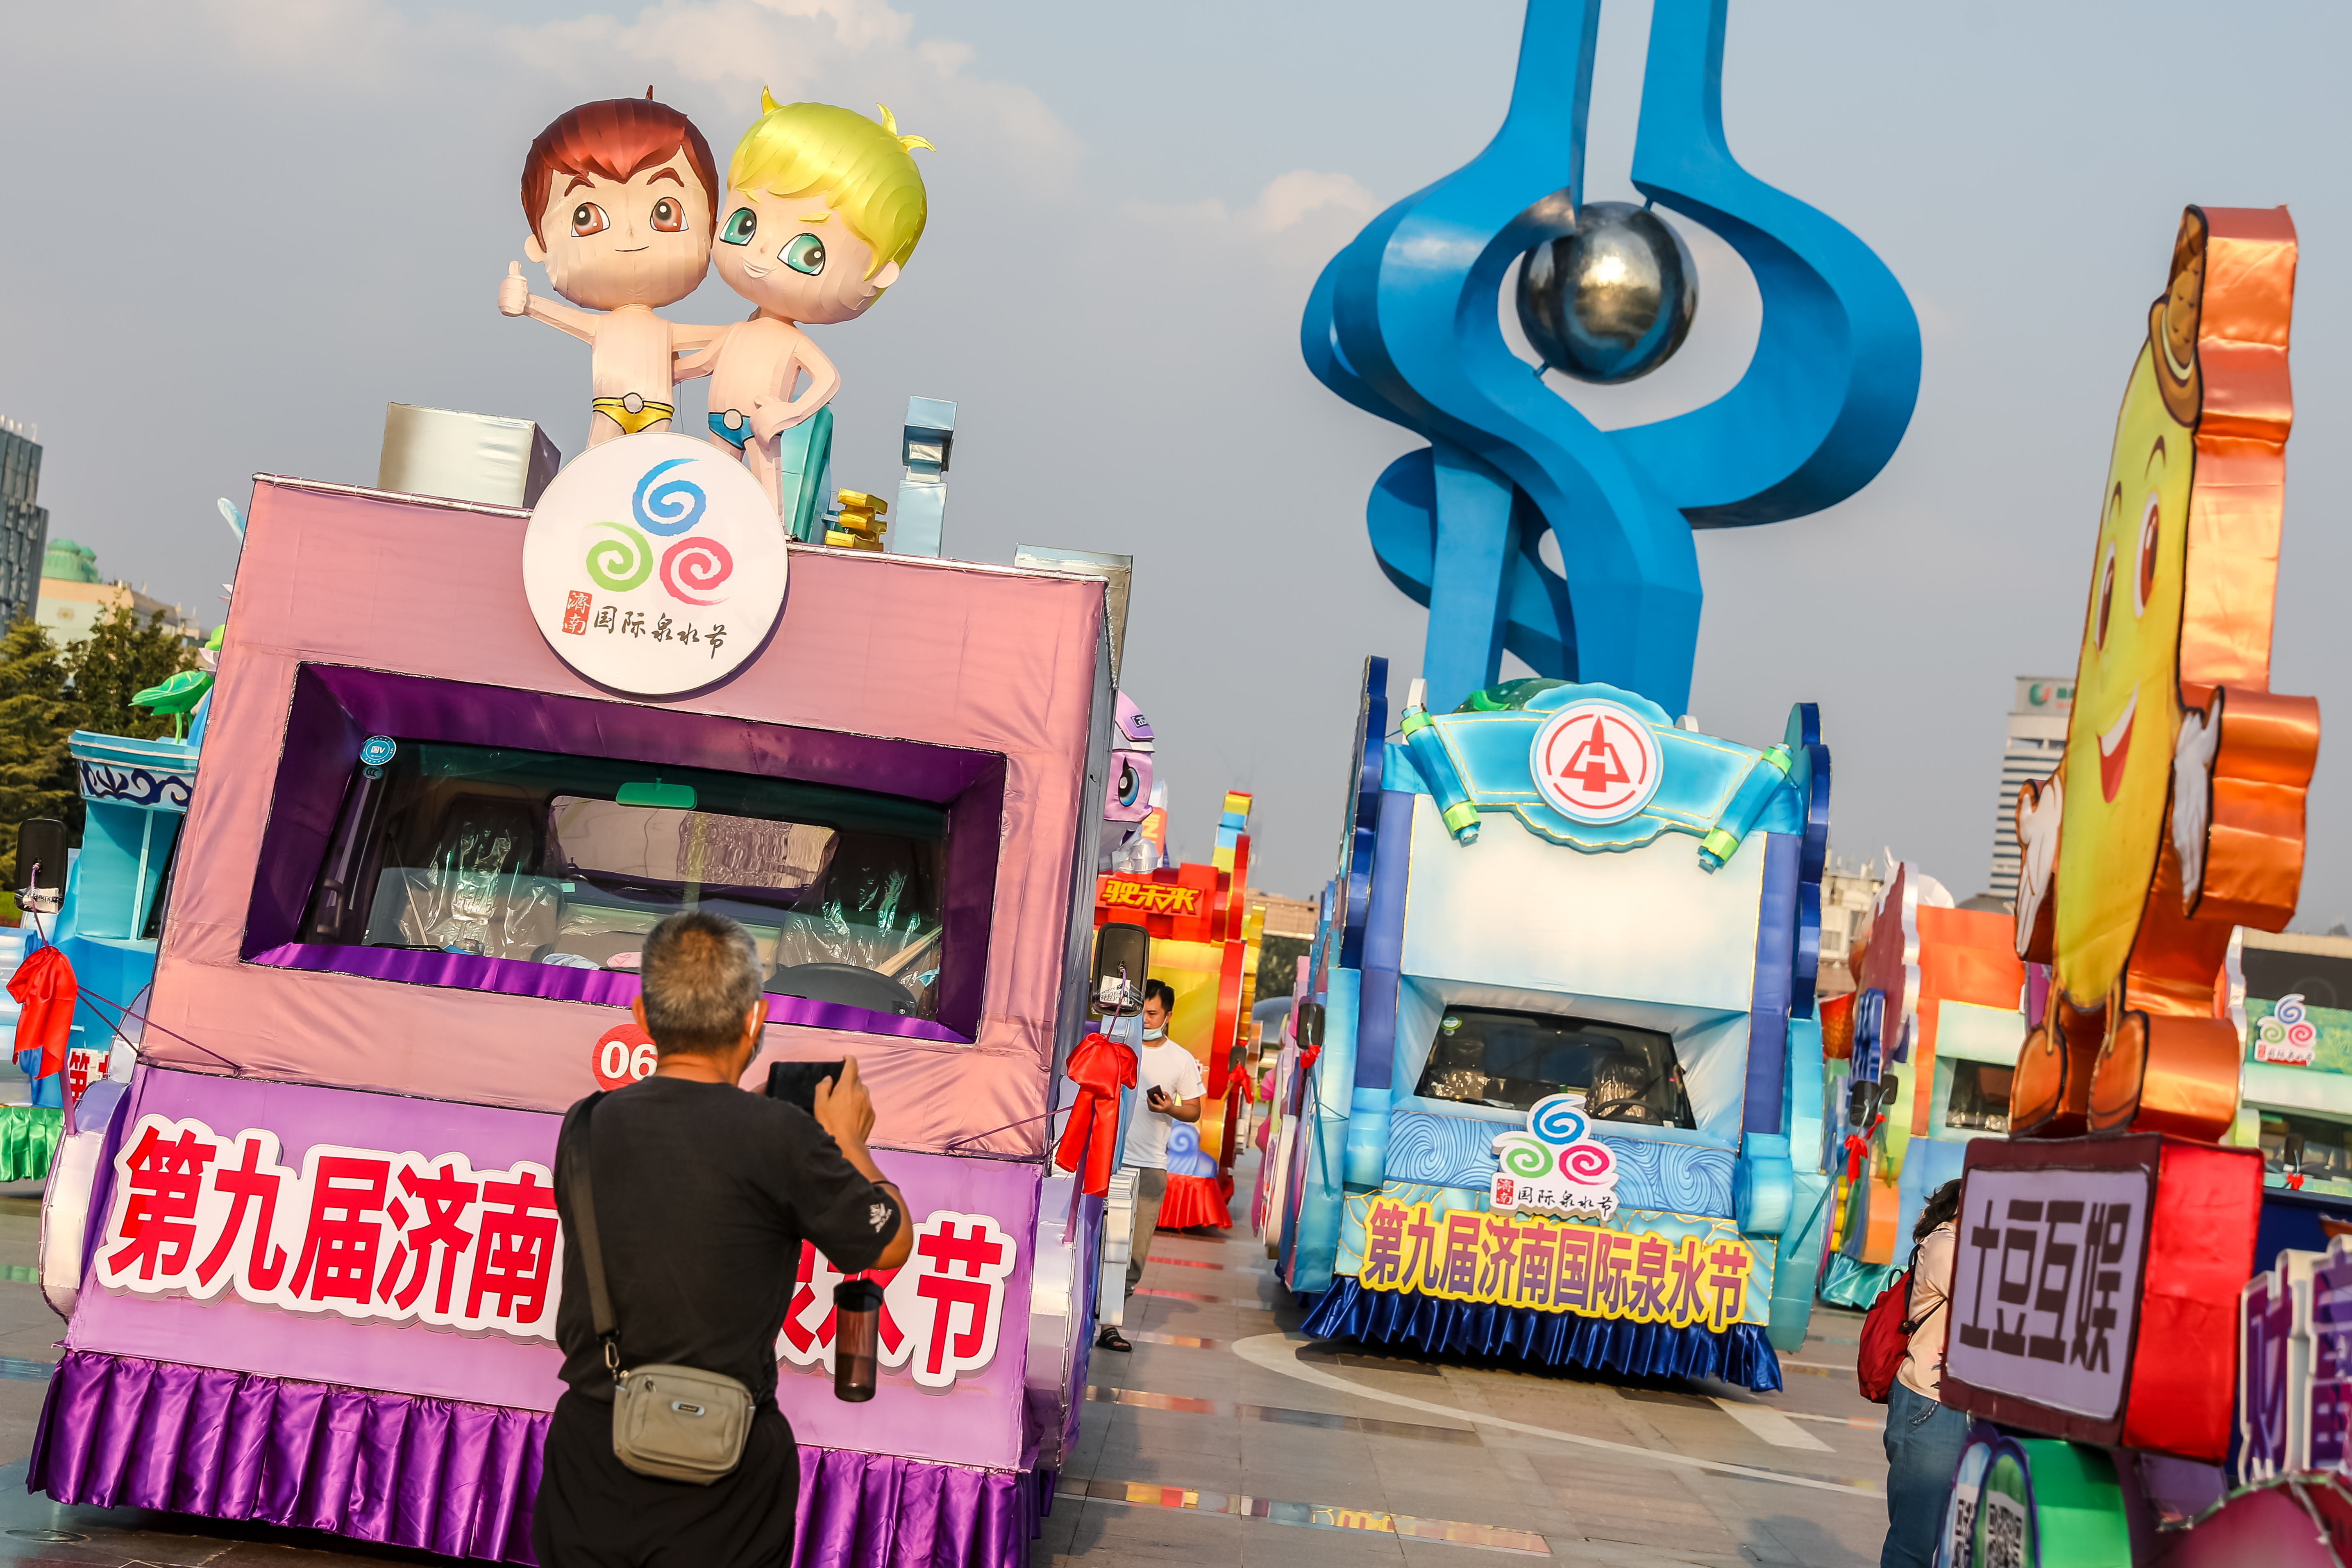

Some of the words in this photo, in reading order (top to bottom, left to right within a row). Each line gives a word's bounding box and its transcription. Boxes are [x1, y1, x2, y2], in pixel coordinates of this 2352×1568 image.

[1102, 880, 1200, 911] 驶未来
[601, 1040, 658, 1081] 06
[1365, 1203, 1747, 1326] 第九届济南国际泉水节
